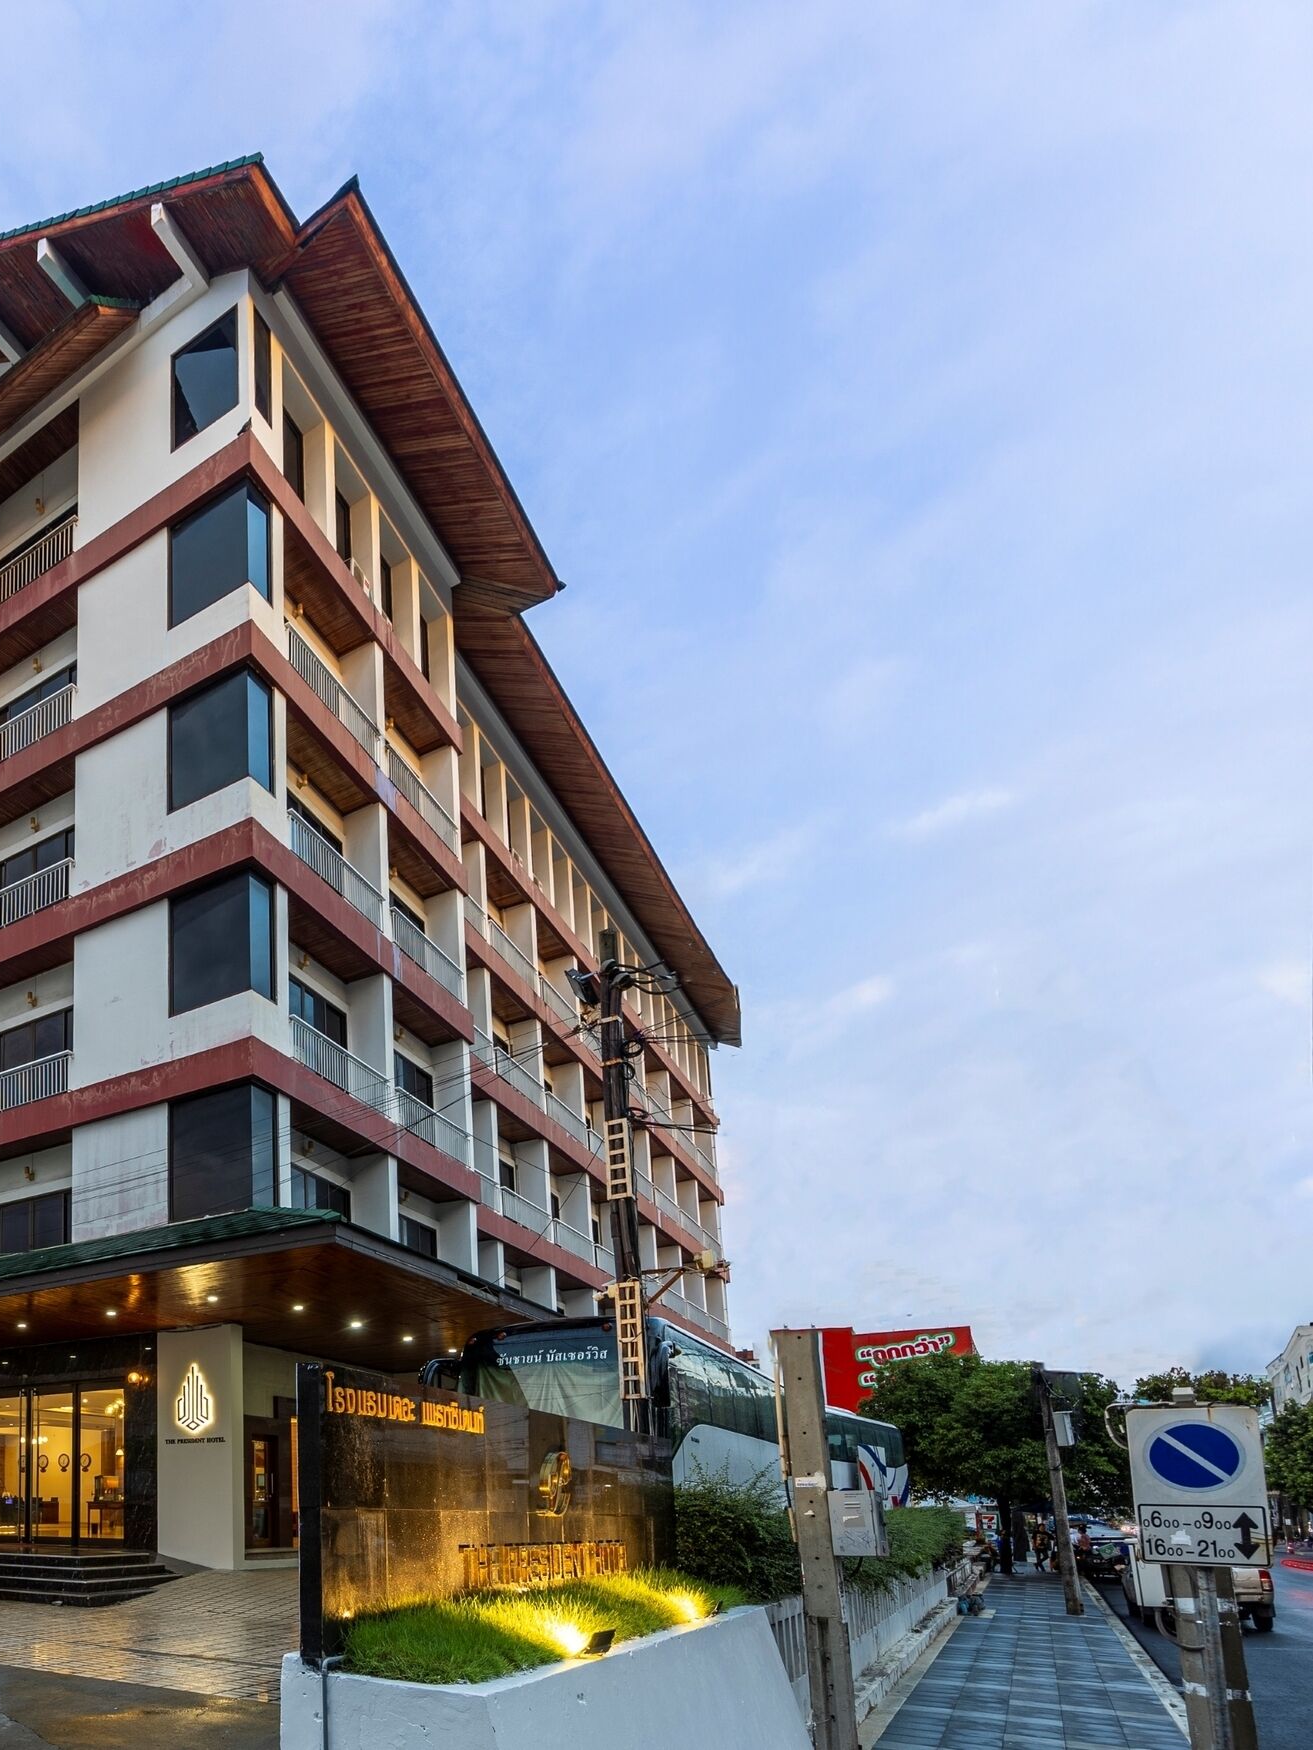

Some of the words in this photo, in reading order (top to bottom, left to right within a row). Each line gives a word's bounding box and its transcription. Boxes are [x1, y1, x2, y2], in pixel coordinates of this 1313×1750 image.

[546, 1346, 608, 1363] บัสเซอร์วิส
[324, 1370, 416, 1422] โรงแรมเดอะ
[177, 1437, 205, 1445] PRESIDENT
